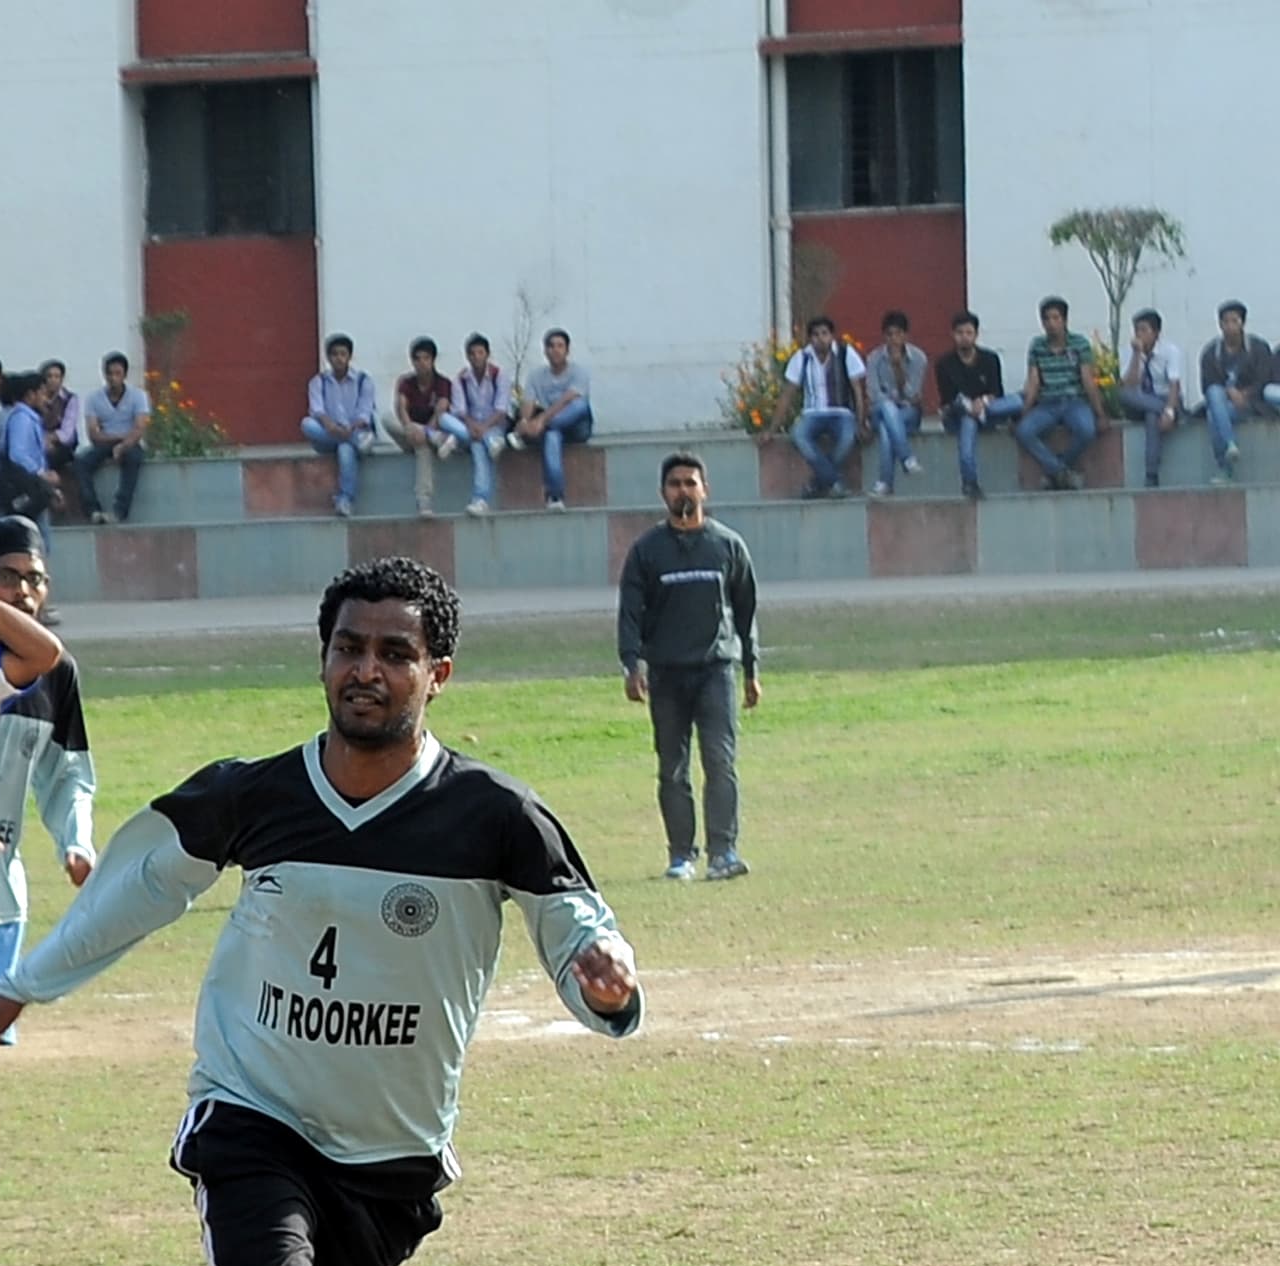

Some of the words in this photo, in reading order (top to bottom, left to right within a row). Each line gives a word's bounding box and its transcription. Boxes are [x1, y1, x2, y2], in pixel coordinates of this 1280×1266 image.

[309, 925, 337, 990] 4
[256, 980, 284, 1030] IIT
[286, 991, 421, 1046] ROORKEE
